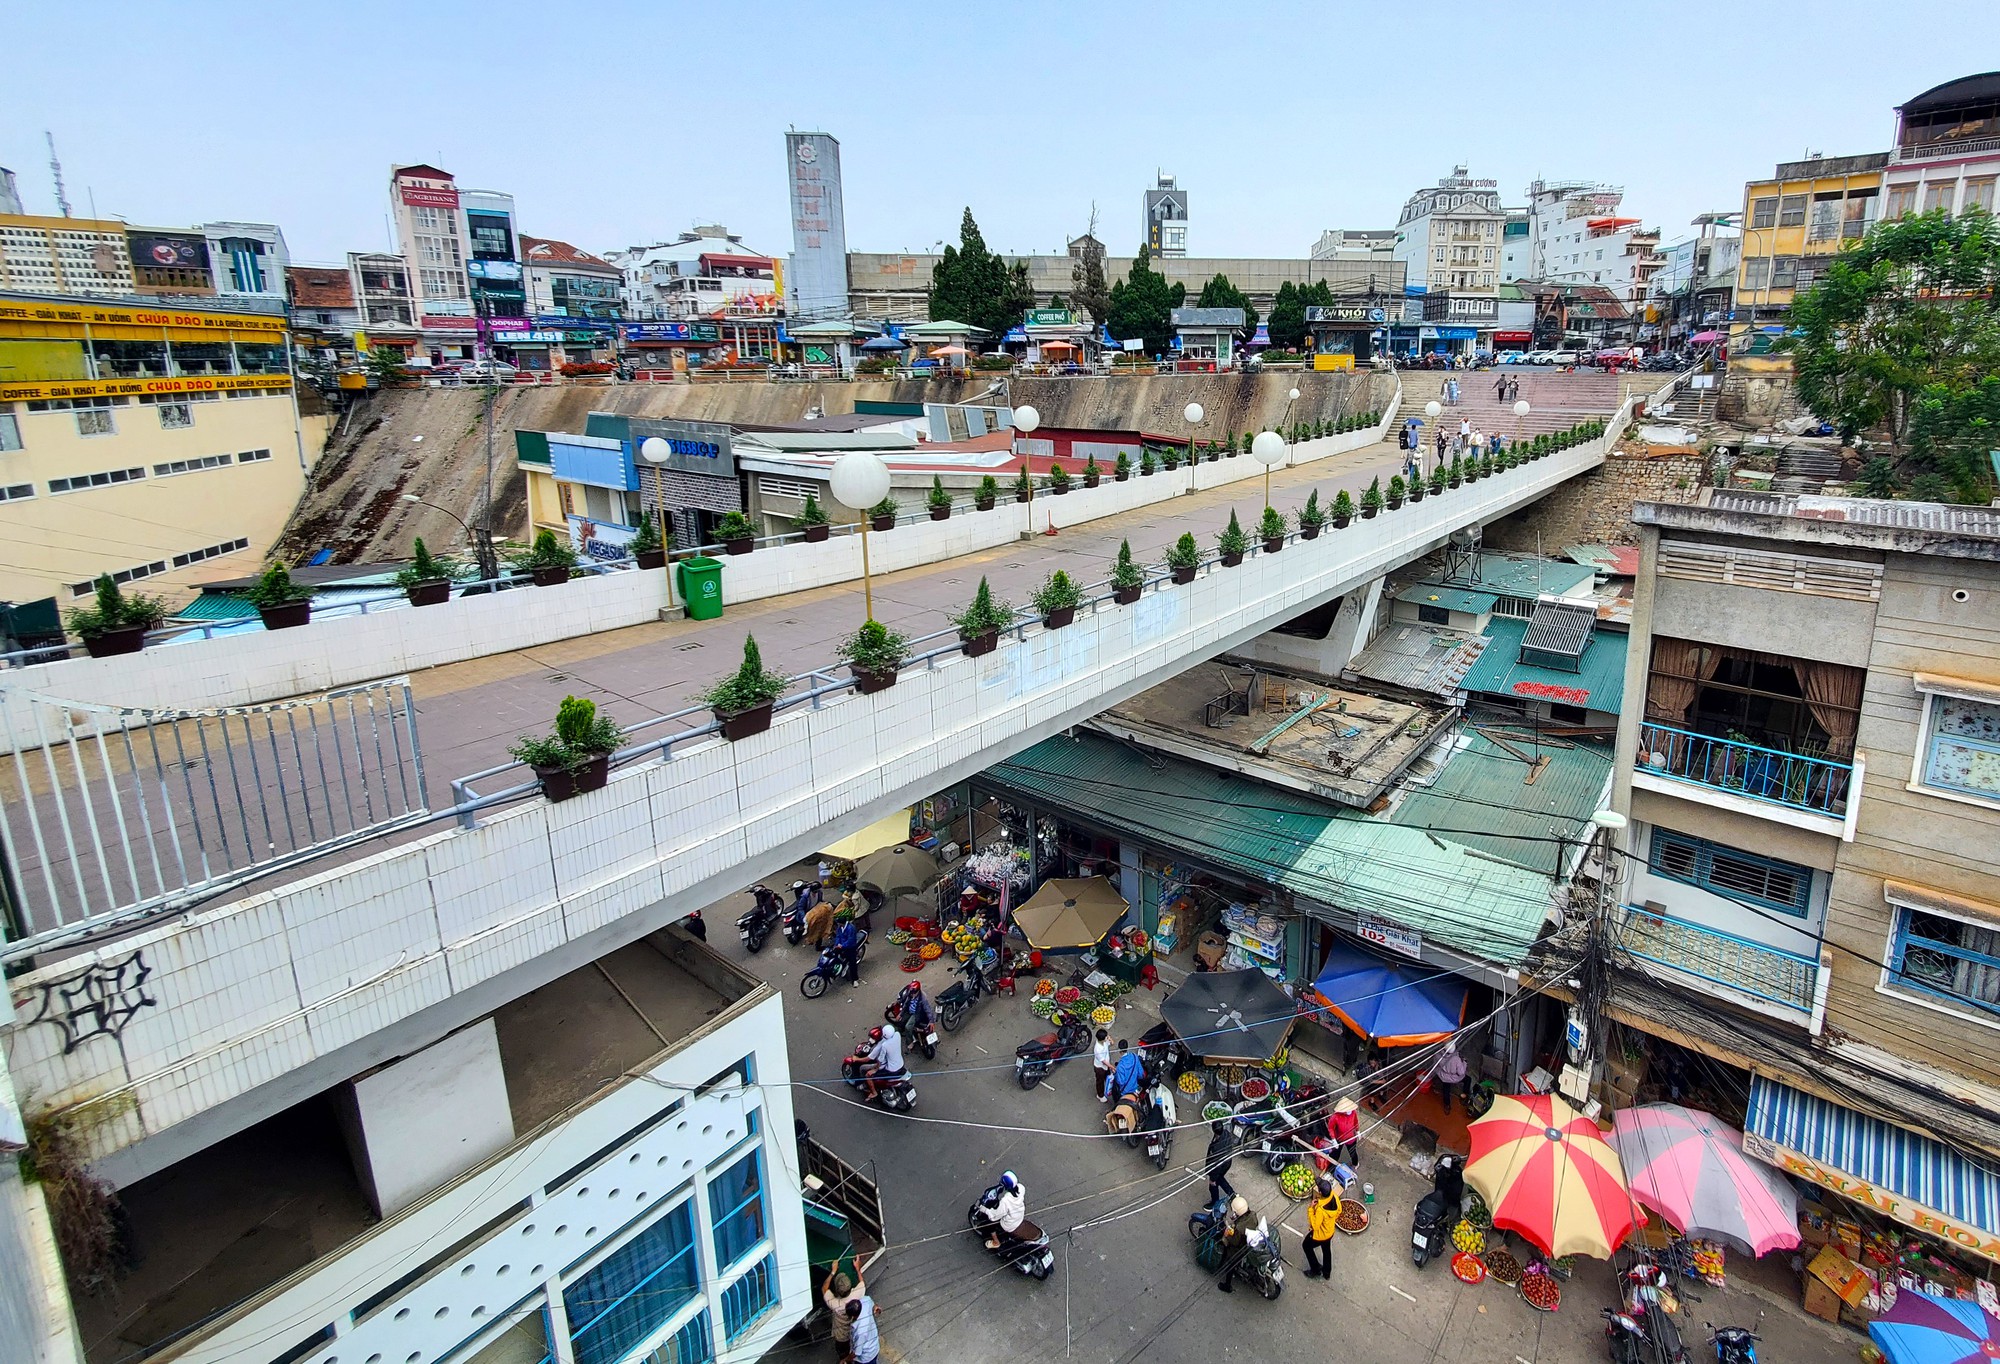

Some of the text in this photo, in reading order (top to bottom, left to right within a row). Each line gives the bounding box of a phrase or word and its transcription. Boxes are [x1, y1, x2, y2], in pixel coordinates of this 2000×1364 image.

[413, 193, 456, 204] AGRIBANK
[1151, 225, 1160, 250] KIM
[1037, 313, 1054, 321] COFFEE
[496, 331, 531, 340] LEN
[3, 388, 42, 399] COFFEE
[587, 540, 627, 560] MEGASUN
[1360, 927, 1386, 944] 102
